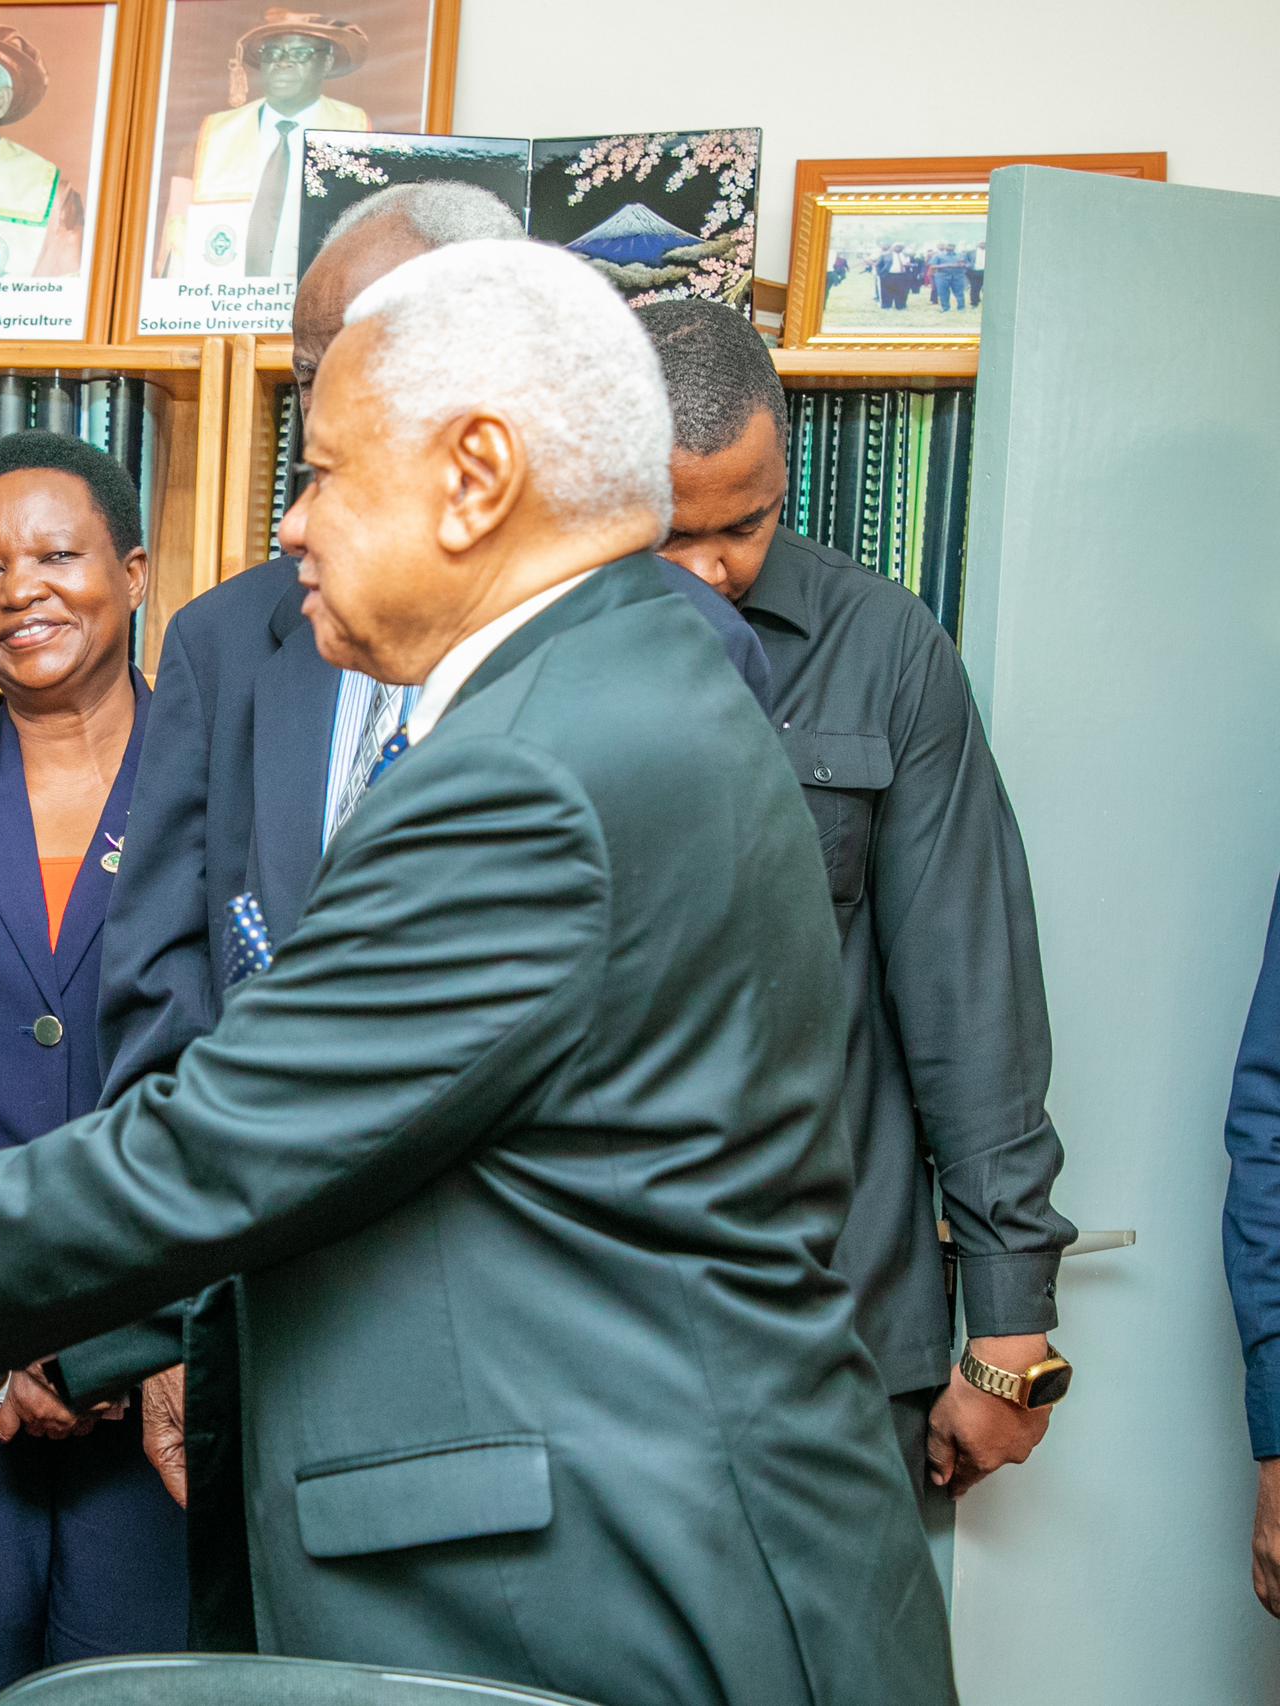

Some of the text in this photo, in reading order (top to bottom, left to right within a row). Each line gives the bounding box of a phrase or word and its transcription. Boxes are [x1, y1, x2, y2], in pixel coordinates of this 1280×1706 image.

[11, 282, 63, 293] Warioba
[177, 284, 213, 297] Prof.
[217, 282, 280, 298] Raphael
[211, 299, 294, 312] Vice chanc
[140, 317, 202, 330] Sokoine
[206, 316, 284, 331] University
